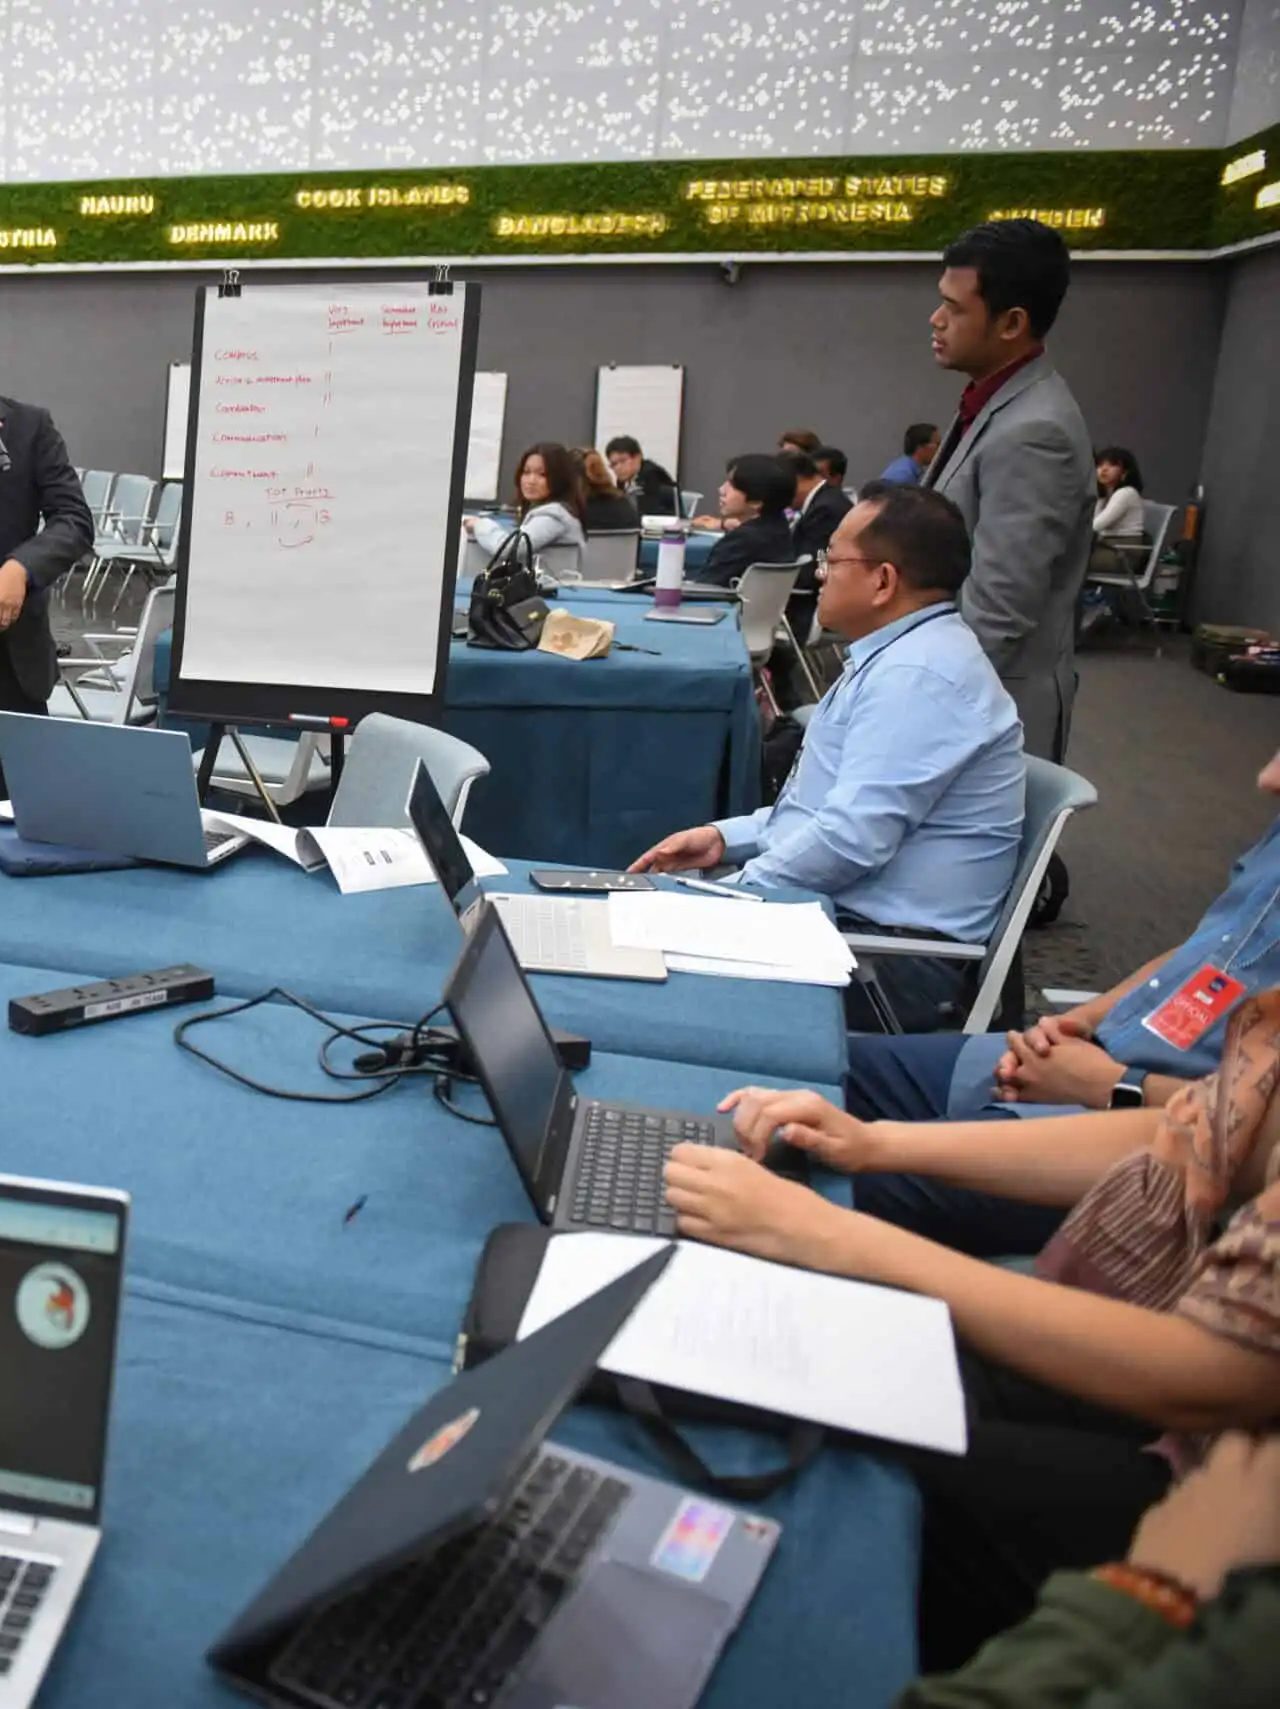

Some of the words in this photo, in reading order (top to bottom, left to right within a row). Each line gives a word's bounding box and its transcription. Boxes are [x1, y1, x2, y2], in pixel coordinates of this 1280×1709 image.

[296, 189, 361, 208] COOK
[368, 185, 469, 207] ISLANDS
[686, 178, 837, 200] FEDERATED
[844, 175, 948, 197] STATES
[80, 196, 154, 215] NAURU
[748, 201, 912, 223] MICRONESIA
[169, 222, 278, 244] DENMARK
[497, 213, 666, 236] BANGLADESH
